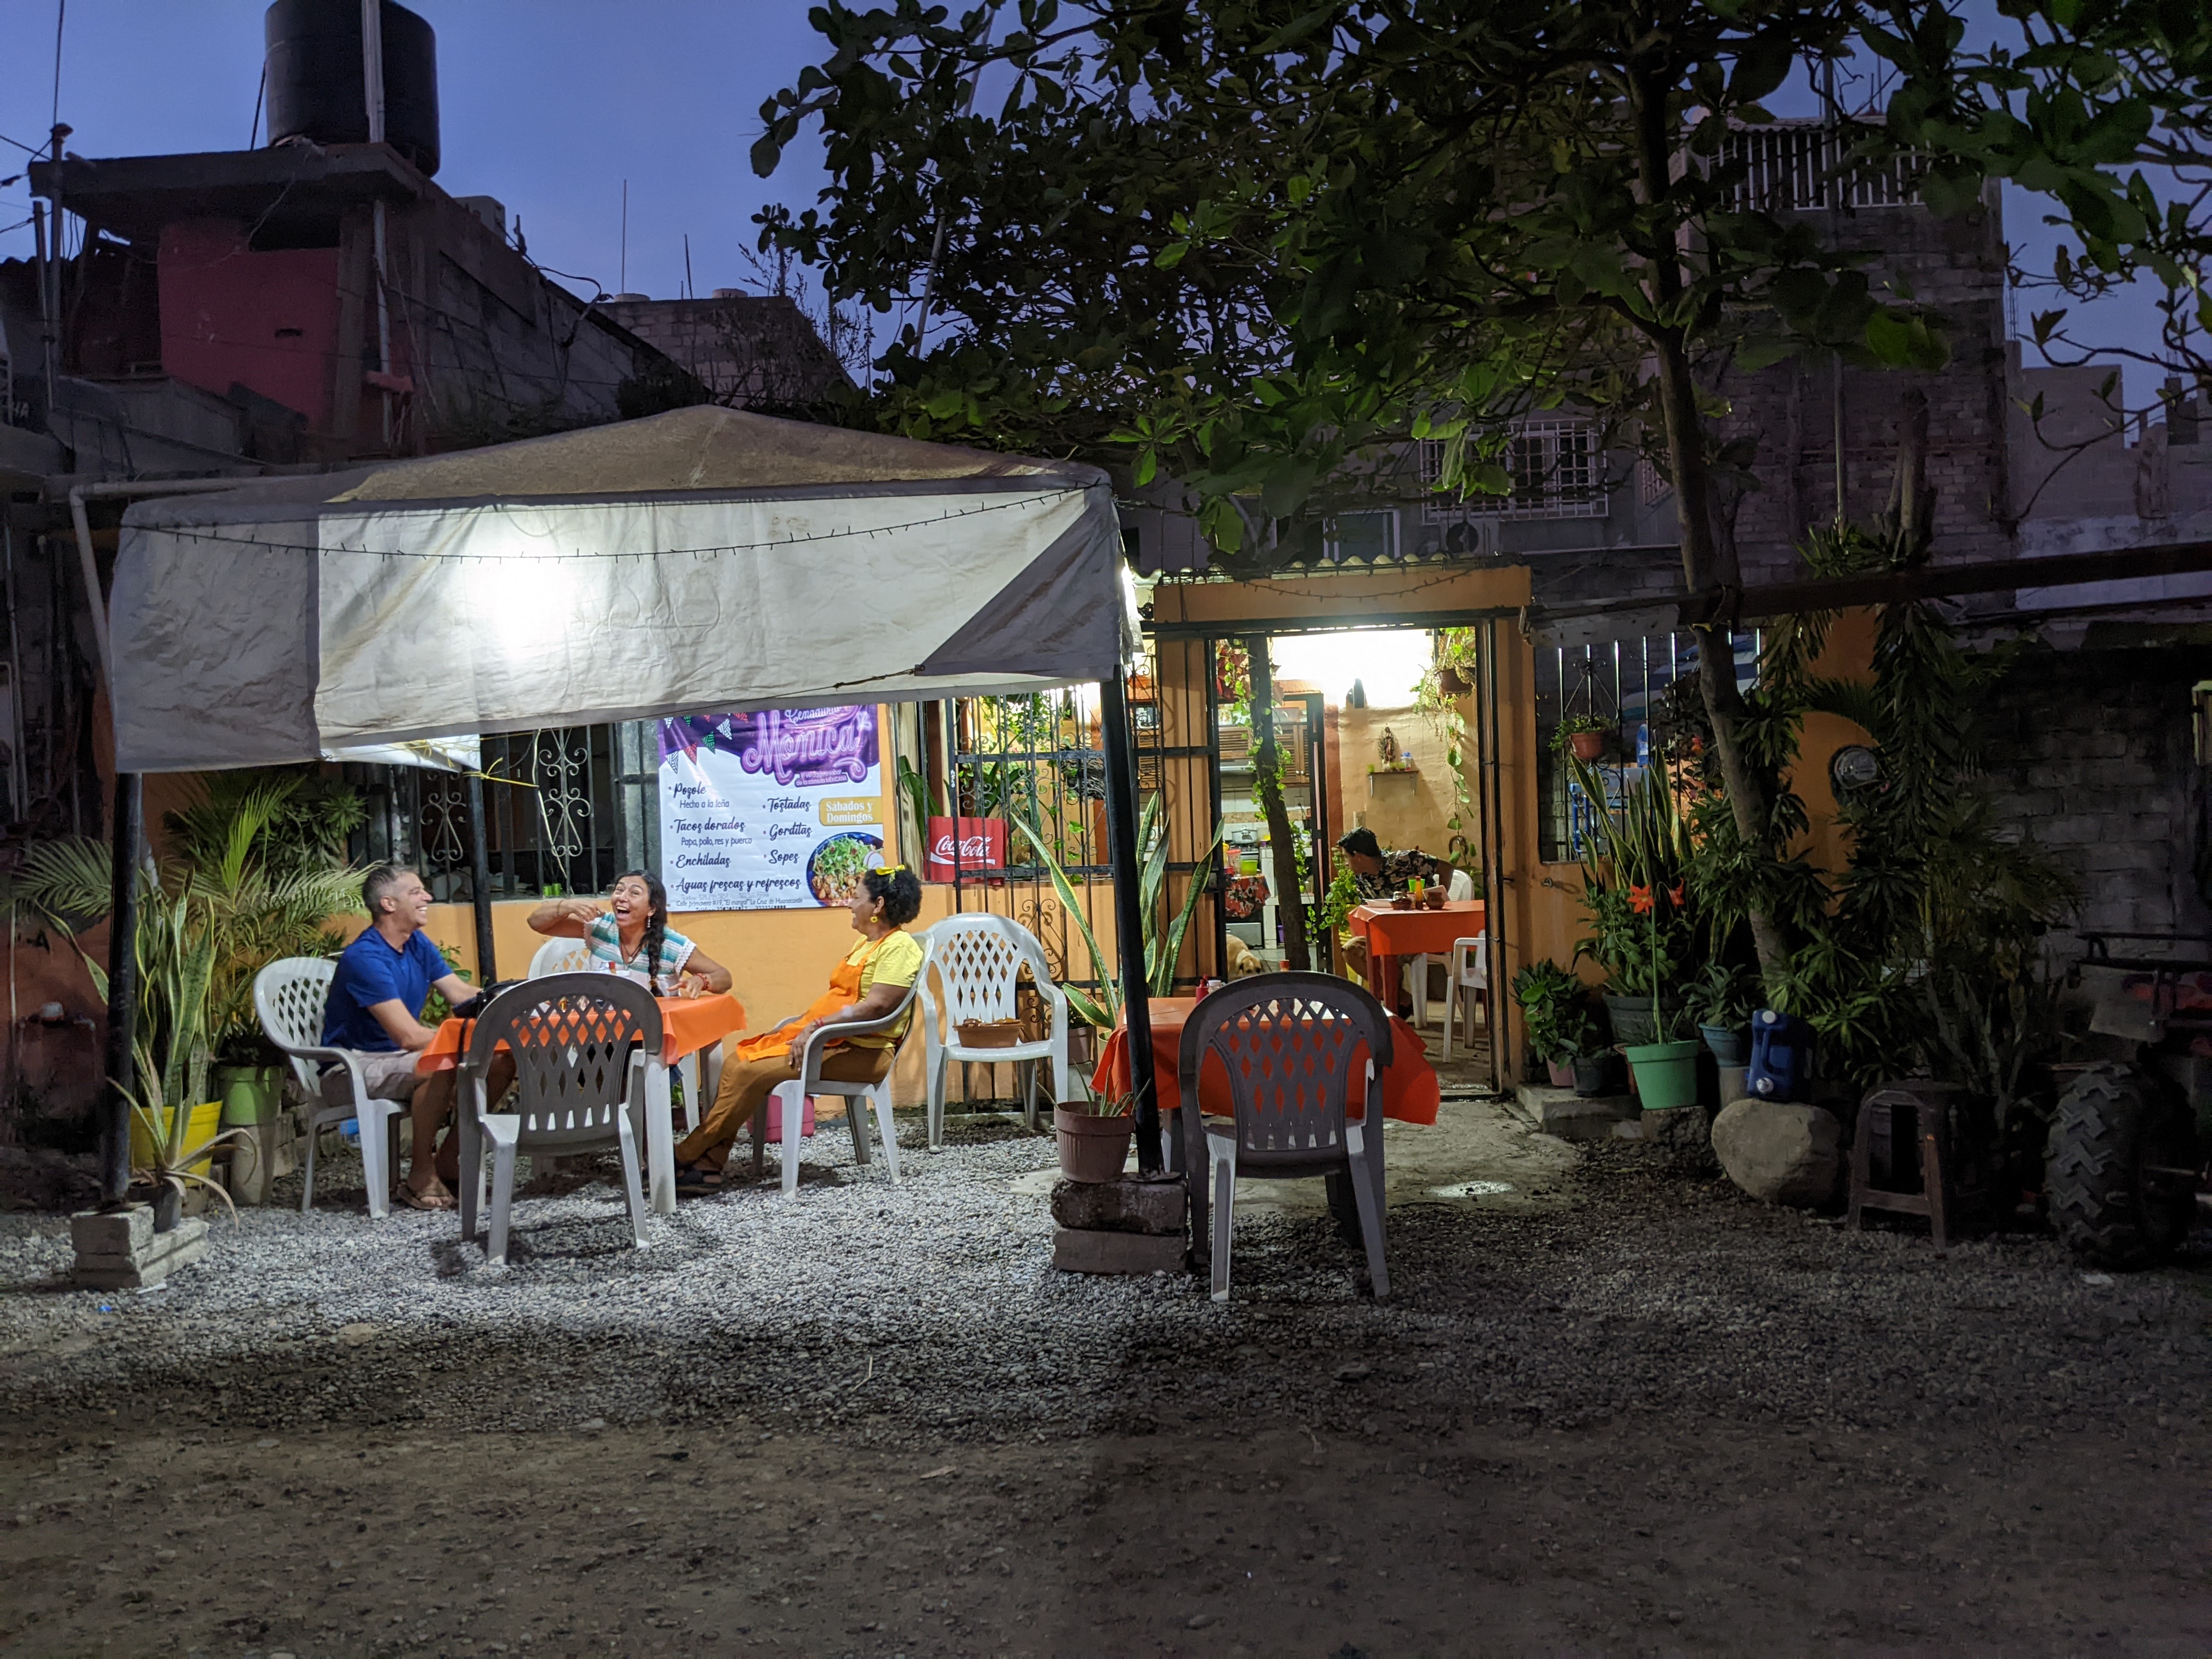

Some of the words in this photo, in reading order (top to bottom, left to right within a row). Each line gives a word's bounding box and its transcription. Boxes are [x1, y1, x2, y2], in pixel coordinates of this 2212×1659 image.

[674, 781, 707, 799] Pozole
[680, 800, 699, 808] Hecho
[708, 799, 713, 808] la
[715, 799, 729, 808] leña
[768, 796, 811, 812] Tostadas
[826, 800, 865, 811] Sábados
[867, 802, 873, 812] y
[674, 818, 703, 833] Tacos
[704, 816, 746, 832] dorados
[827, 812, 873, 823] Domingos
[769, 822, 812, 840] Gorditas
[681, 837, 698, 847] Papa,
[725, 839, 729, 847] y
[731, 838, 752, 847] puerco
[936, 835, 993, 856] Coca-Cola
[676, 852, 731, 868] Enchiladas
[769, 849, 799, 865] Sopes
[676, 878, 709, 894] Aguas
[709, 880, 746, 894] frescas
[747, 880, 754, 893] y
[755, 878, 801, 892] refrescos
